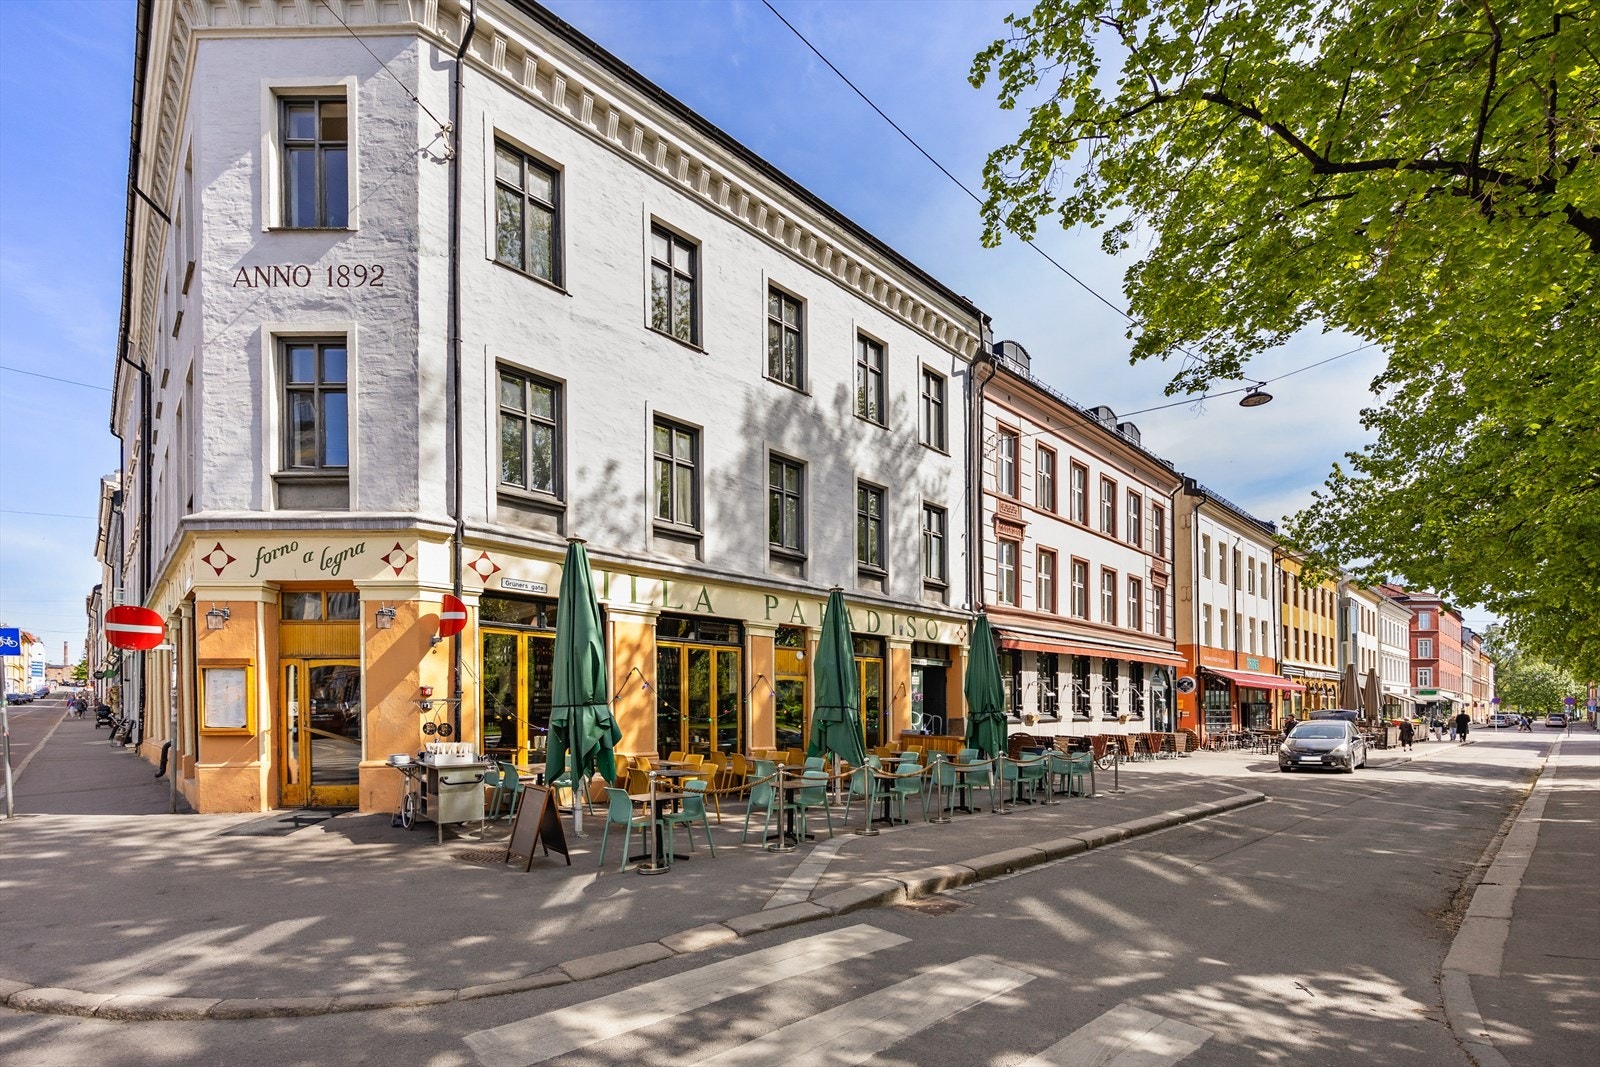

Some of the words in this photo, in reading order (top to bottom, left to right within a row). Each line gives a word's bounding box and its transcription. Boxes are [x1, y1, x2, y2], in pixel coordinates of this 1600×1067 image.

[232, 265, 312, 288] ANNO
[327, 264, 385, 288] 1892
[250, 541, 299, 578] forno
[303, 550, 314, 564] a
[319, 541, 366, 577] legna
[505, 580, 529, 589] Grüners
[556, 562, 715, 614] ILLA
